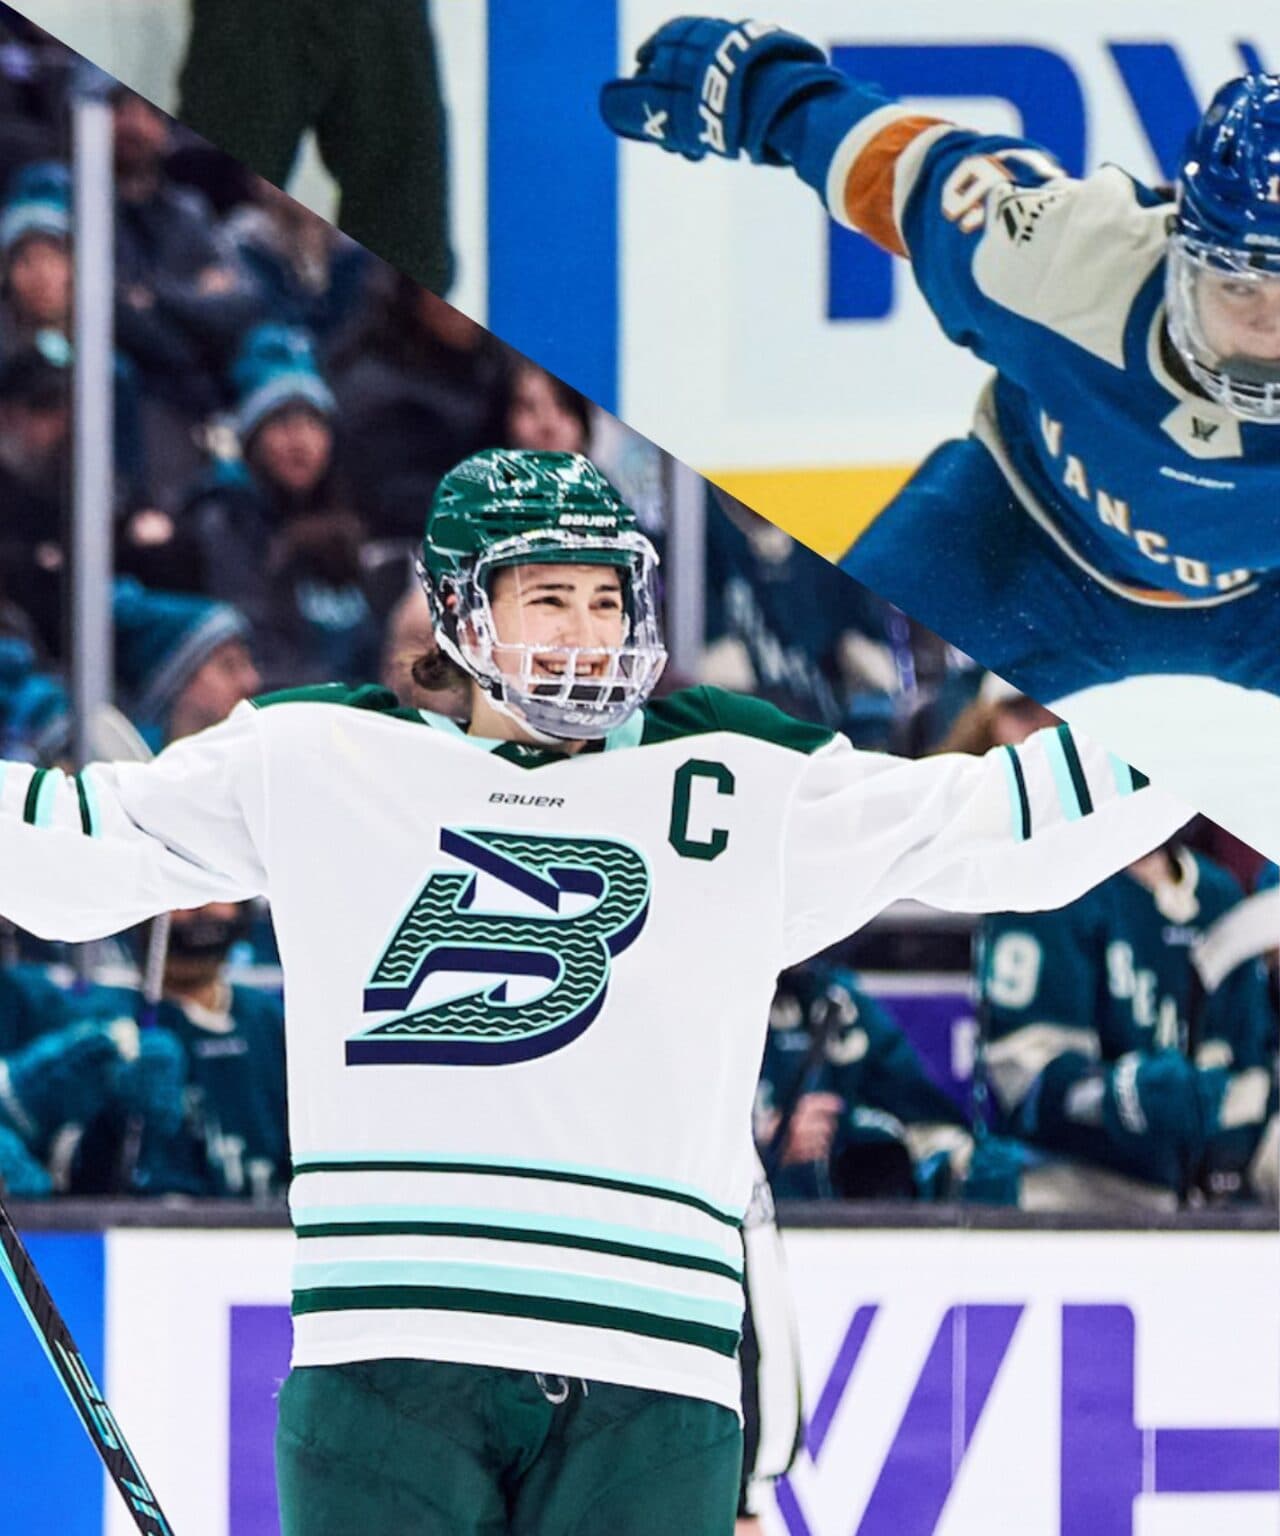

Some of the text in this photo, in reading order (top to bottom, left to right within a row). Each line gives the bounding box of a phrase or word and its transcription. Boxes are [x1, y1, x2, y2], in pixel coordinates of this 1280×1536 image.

[699, 19, 781, 153] UER
[558, 512, 618, 528] BAUER
[1040, 408, 1268, 591] VANCOU
[487, 792, 566, 809] BAUER
[668, 758, 737, 862] C
